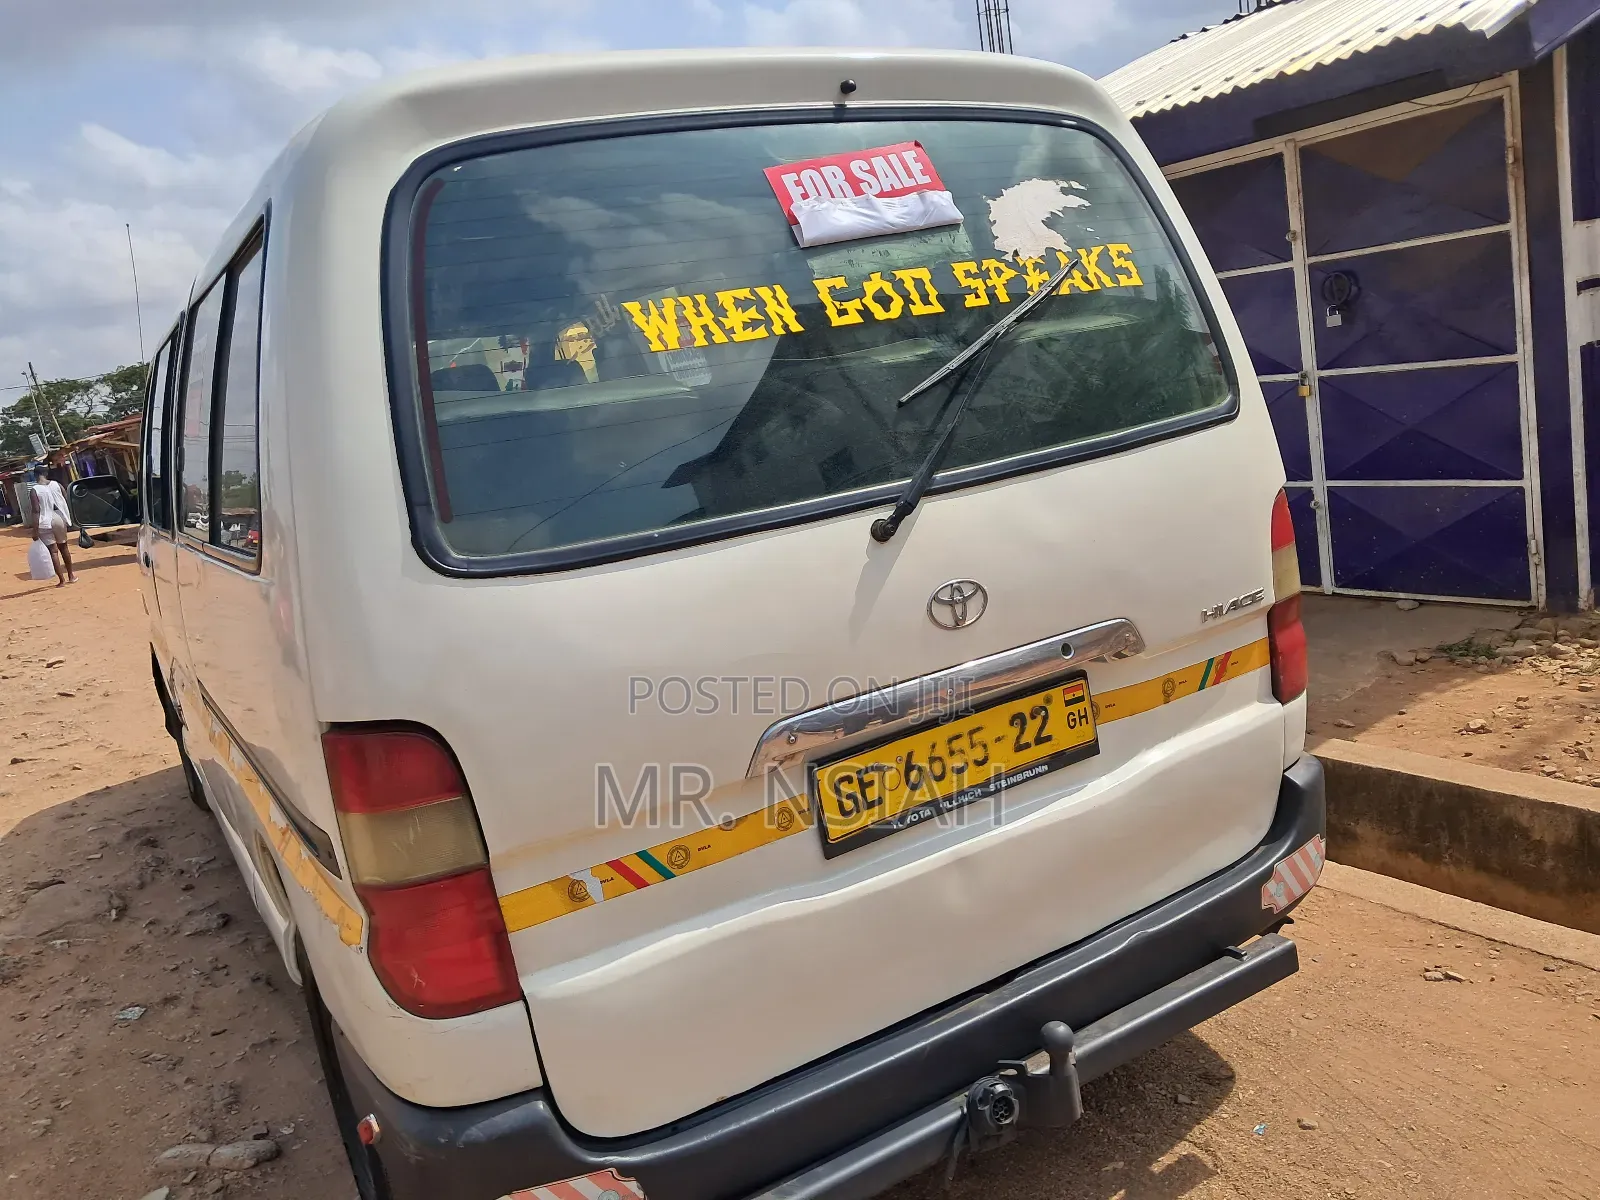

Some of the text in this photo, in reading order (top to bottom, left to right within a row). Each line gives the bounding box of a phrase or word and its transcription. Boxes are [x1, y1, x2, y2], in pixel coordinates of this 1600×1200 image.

[781, 150, 932, 203] FOR SALE
[621, 243, 1144, 352] WHEN GOD SPEAKS
[1201, 586, 1265, 623] HIACE
[1066, 707, 1089, 730] GH
[989, 764, 1049, 791] STEINBRUNN
[697, 844, 712, 852] DVLA
